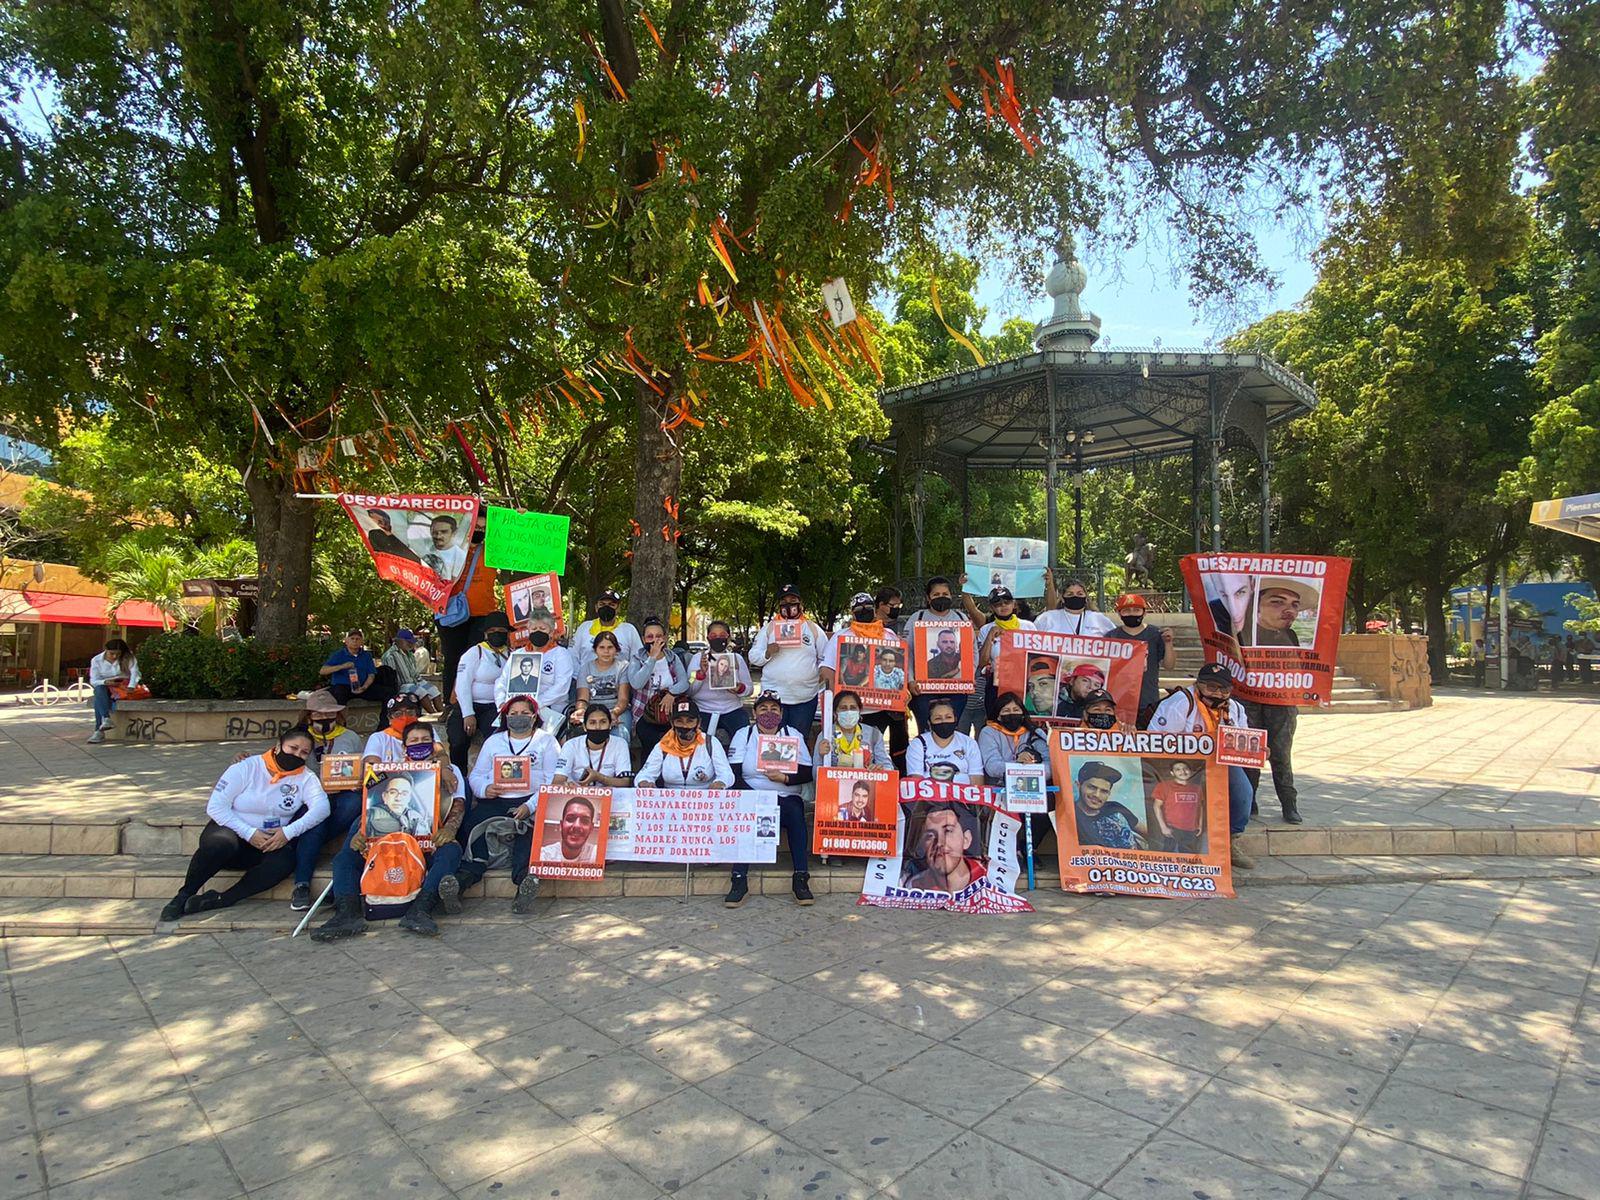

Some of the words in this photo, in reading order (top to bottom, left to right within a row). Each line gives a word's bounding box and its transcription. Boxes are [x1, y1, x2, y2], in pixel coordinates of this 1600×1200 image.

[343, 495, 474, 510] DESAPARECIDO
[1197, 557, 1327, 576] DESAPARECIDO
[915, 621, 971, 629] DESAPARECIDO
[845, 636, 901, 648] DESAPARECIDO
[1013, 632, 1134, 660] DESAPARECIDO
[1246, 672, 1314, 689] 6703600
[1060, 731, 1215, 756] DESAPARECIDO
[826, 770, 889, 781] DESAPARECIDO
[540, 785, 612, 797] DESAPARECIDO
[636, 789, 655, 798] QUE
[660, 790, 675, 798] LOS
[680, 790, 702, 798] OJOS
[707, 790, 720, 798] DE
[725, 790, 741, 798] LOS
[636, 800, 714, 809] DESAPARECIDOS
[719, 801, 735, 809] LOS
[636, 811, 665, 820] SIGAN
[682, 812, 713, 821] DONDE
[720, 812, 756, 821] VAYAN
[636, 823, 641, 831] Y
[648, 823, 664, 831] LOS
[668, 823, 711, 832] LLANTOS
[716, 824, 729, 832] DE
[733, 825, 750, 833] SUS
[634, 834, 677, 844] MADRES
[682, 835, 713, 844] NUNCA
[719, 836, 735, 844] LOS
[833, 838, 850, 849] 800
[851, 839, 888, 850] 6703600
[634, 846, 664, 855] DEJEN
[670, 847, 711, 856] DORMIR
[1122, 852, 1137, 860] 2020
[530, 865, 603, 877] 018006703600
[1071, 854, 1096, 866] JESÚS
[1098, 856, 1138, 869] LEONARDO
[1140, 861, 1179, 873] PELESTER
[1181, 864, 1220, 876] GASTELUM
[1089, 868, 1216, 891] 01800077628
